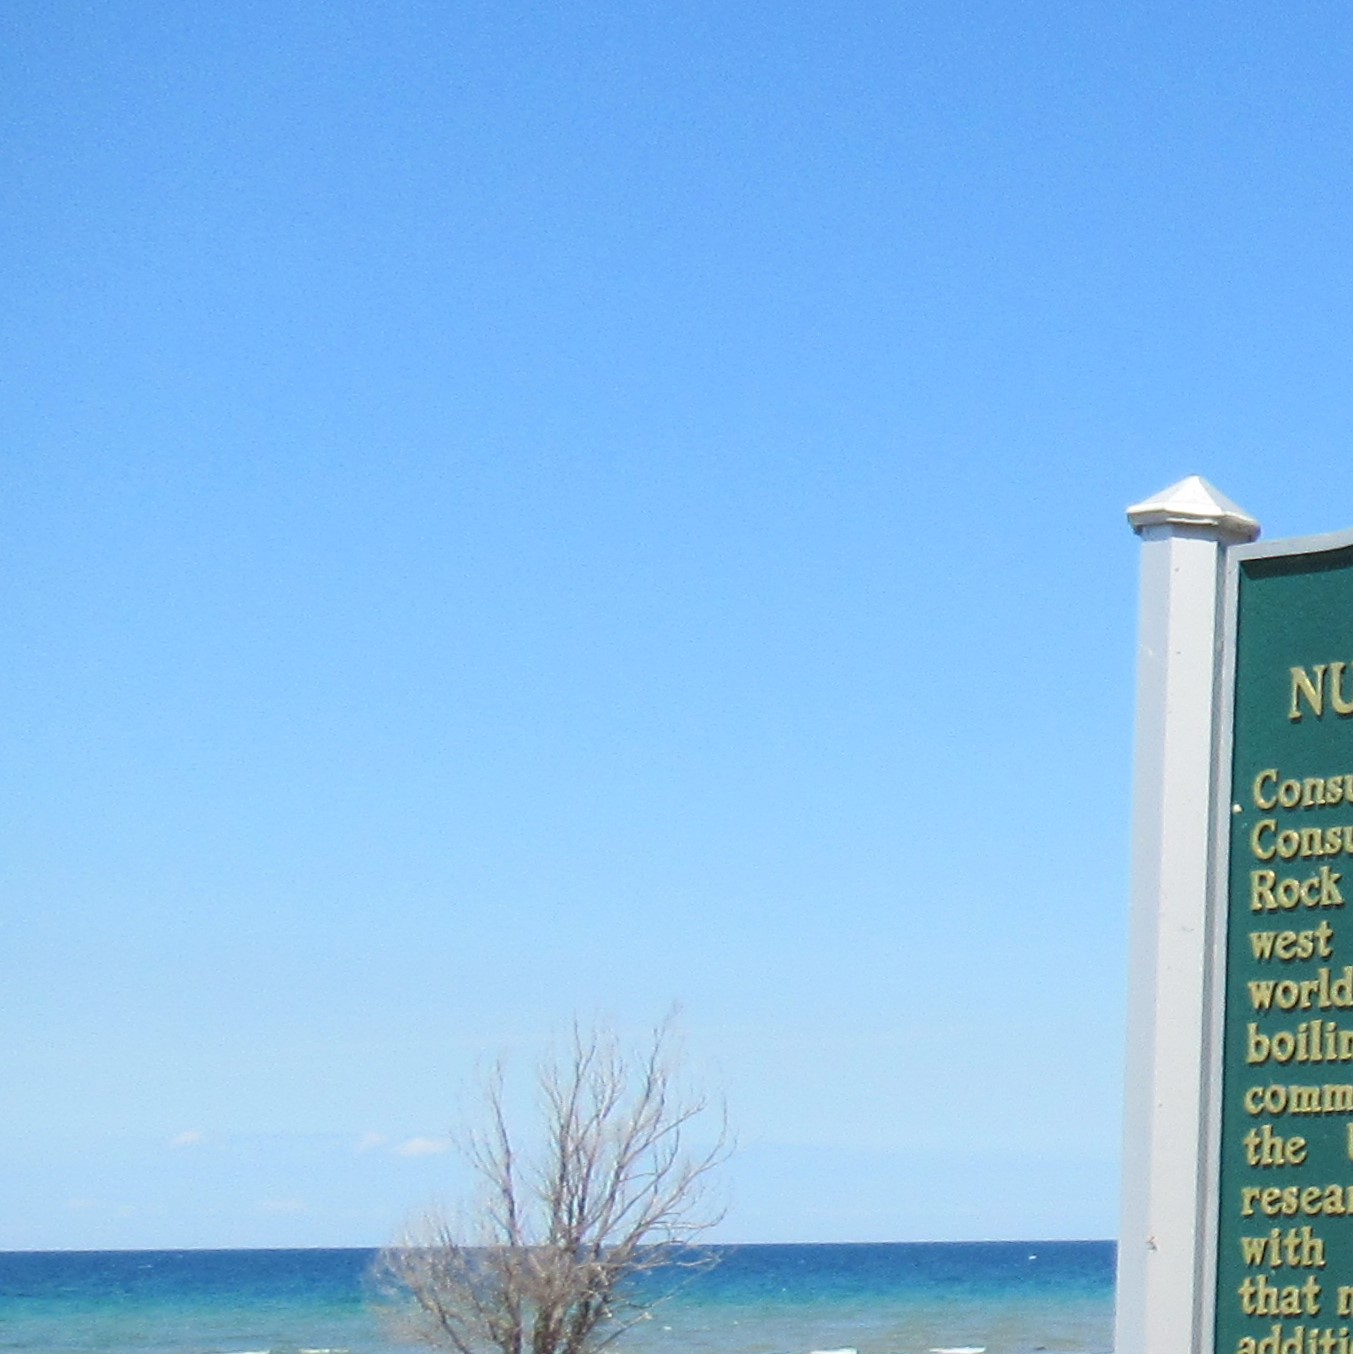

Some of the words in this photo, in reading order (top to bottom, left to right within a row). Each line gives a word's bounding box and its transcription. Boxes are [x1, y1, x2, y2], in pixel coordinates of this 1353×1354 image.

[1252, 868, 1342, 909] Rock
[1252, 923, 1332, 959] west
[1245, 1126, 1305, 1165] the
[1243, 1228, 1325, 1266] with
[1240, 1276, 1319, 1315] that
